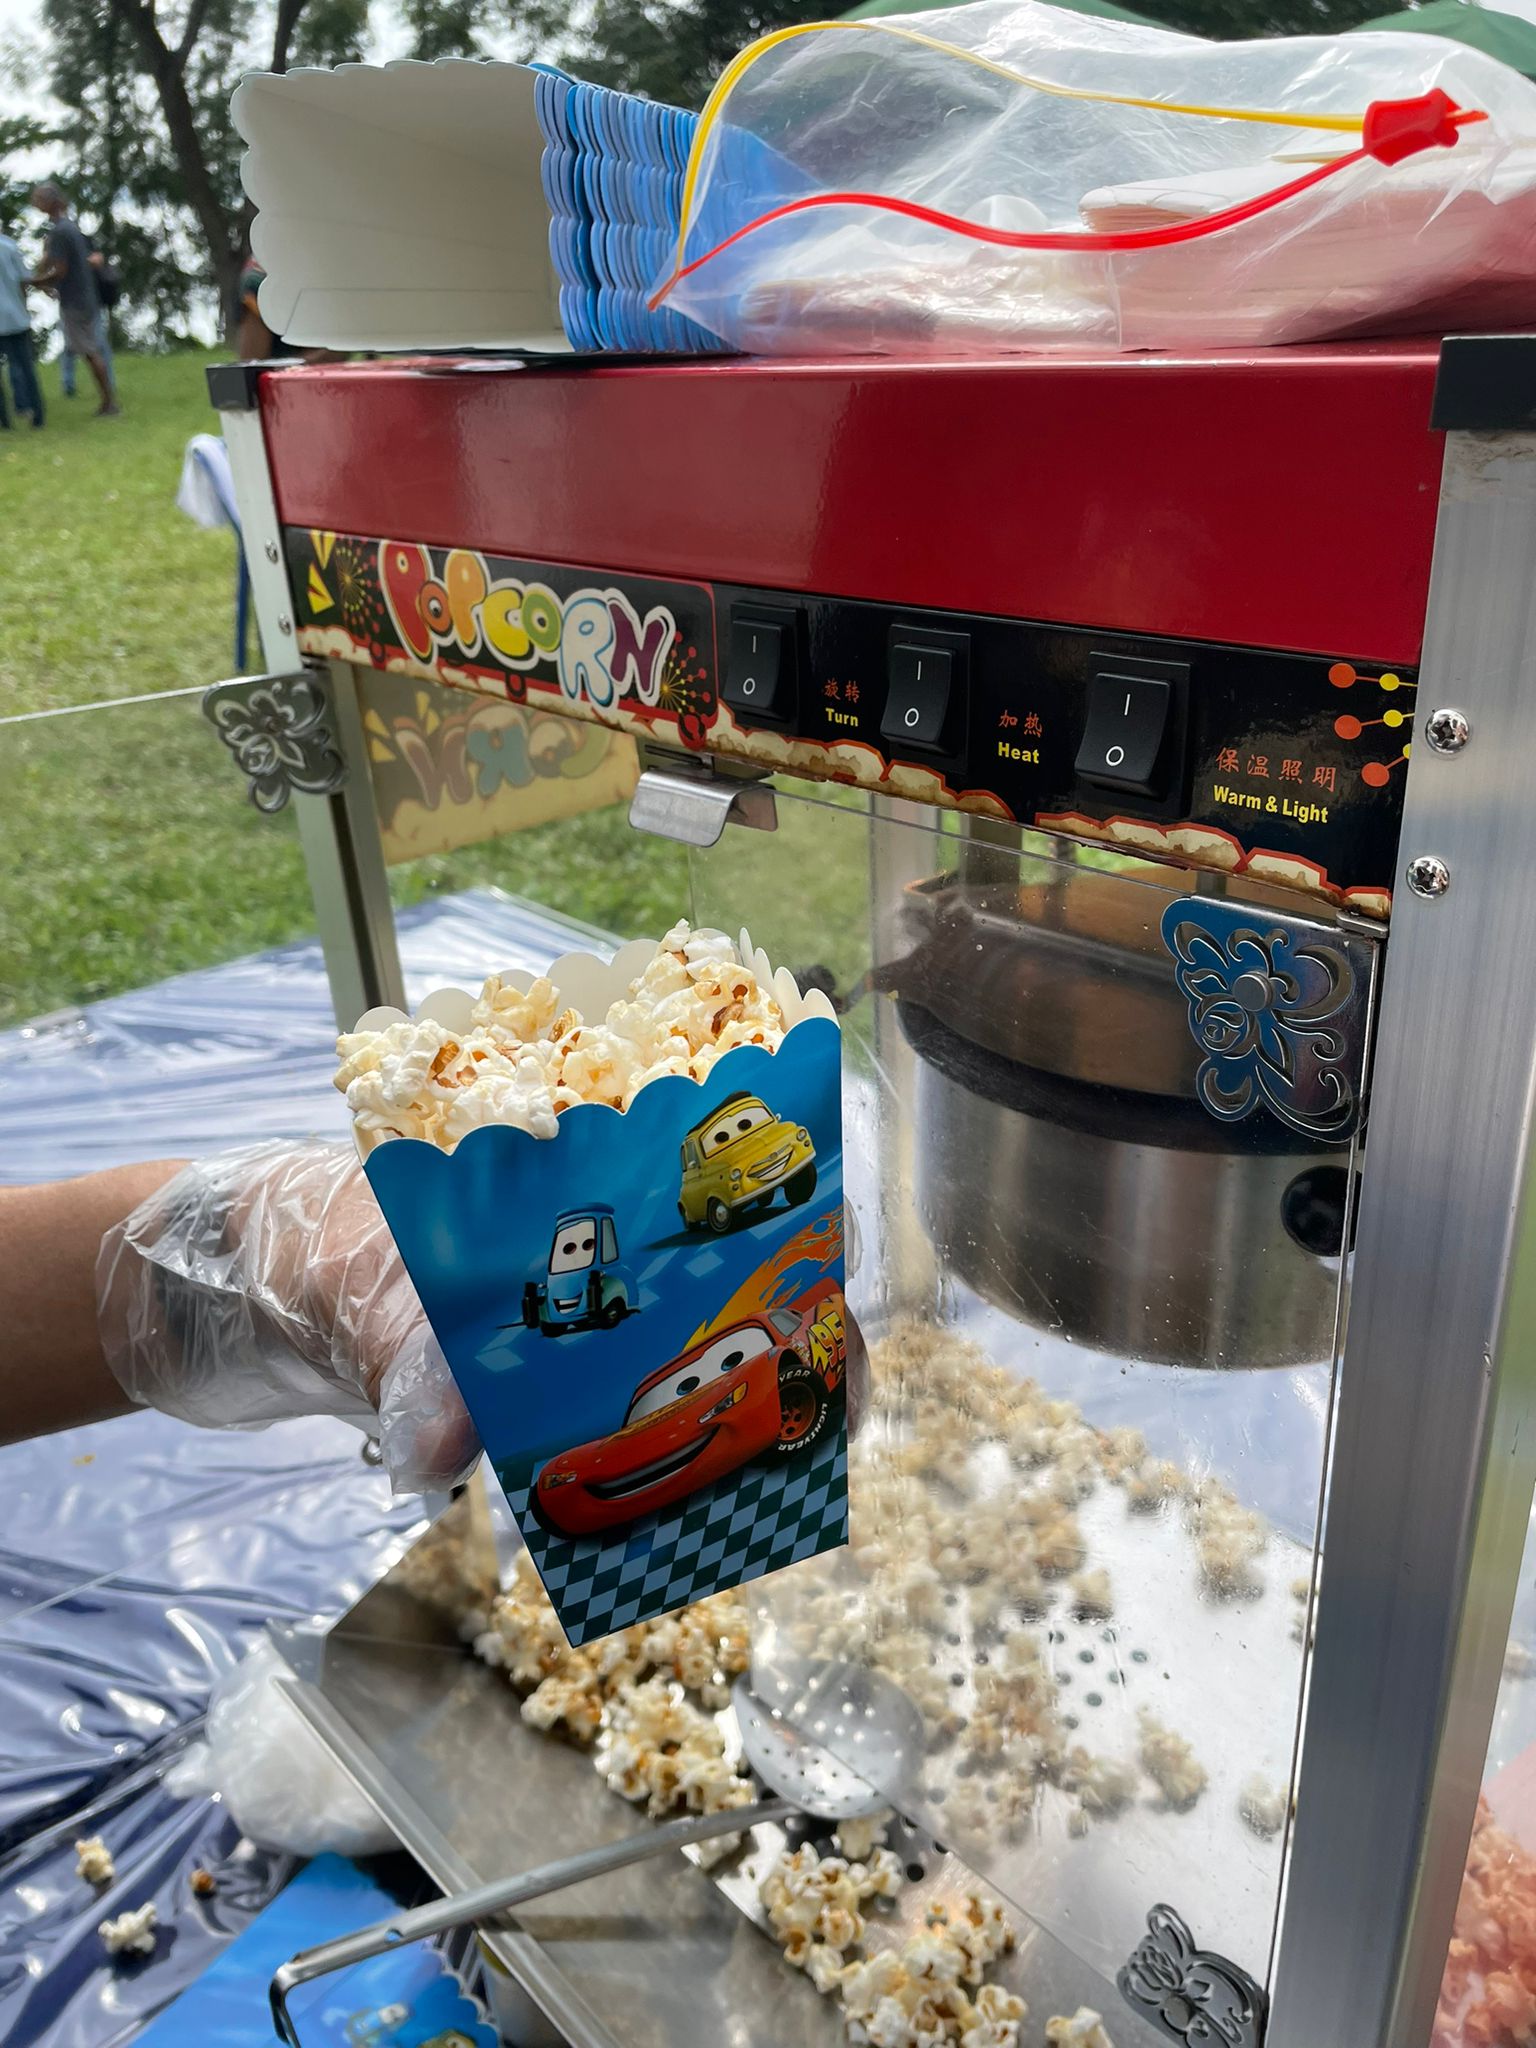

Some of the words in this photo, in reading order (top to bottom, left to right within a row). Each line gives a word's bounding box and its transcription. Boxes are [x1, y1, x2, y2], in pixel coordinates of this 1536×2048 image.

[823, 677, 861, 703] 旋转
[825, 707, 859, 727] Turn
[998, 709, 1043, 738] 加热
[997, 741, 1040, 764] Heat
[1215, 746, 1337, 793] 保温照明
[1213, 784, 1261, 810] Warm
[1265, 795, 1278, 814] &
[1282, 798, 1329, 824] Light
